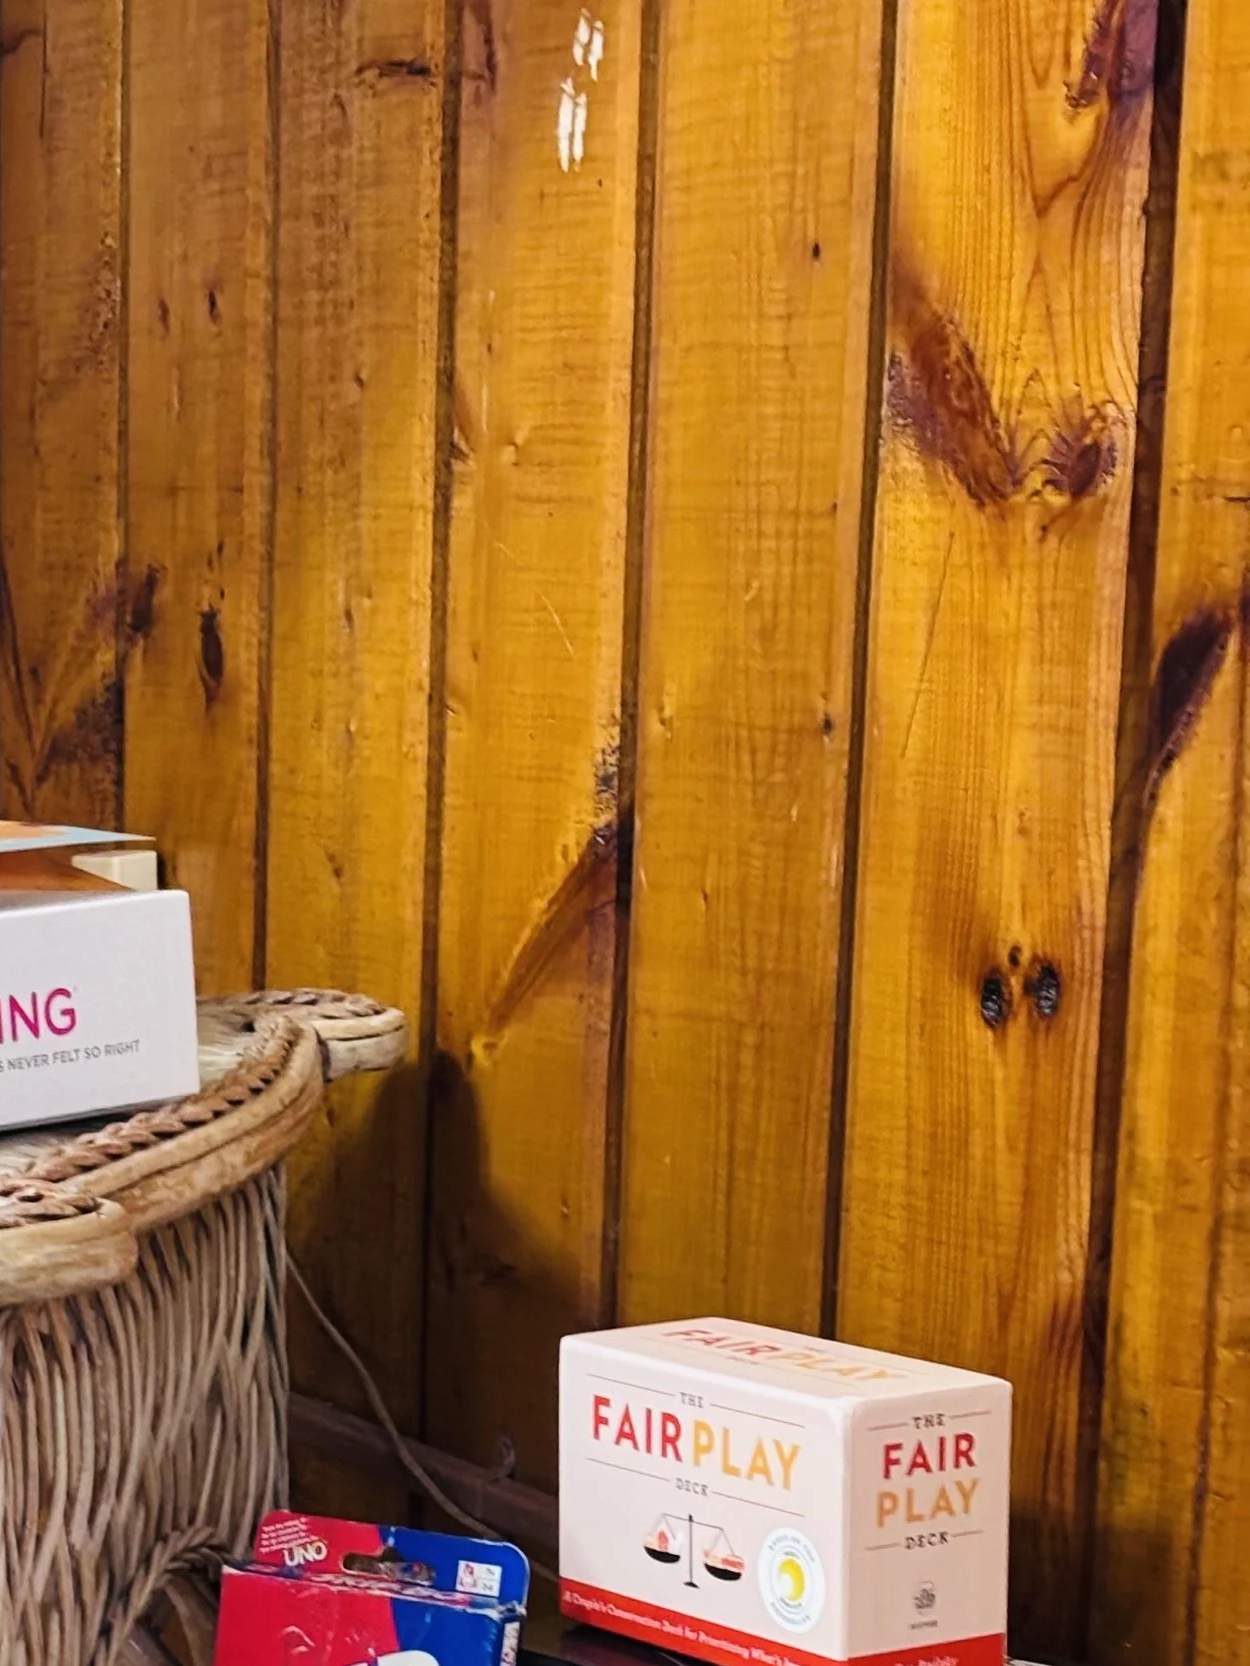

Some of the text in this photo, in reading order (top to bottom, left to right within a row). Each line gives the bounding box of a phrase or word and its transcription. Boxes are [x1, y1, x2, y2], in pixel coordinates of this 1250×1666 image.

[7, 1052, 50, 1071] NEVER
[52, 1048, 82, 1066] FELT
[84, 1045, 102, 1062] SO
[104, 1039, 140, 1057] RIGHT
[911, 1412, 946, 1430] THE
[591, 1393, 802, 1491] FAIR PLAY
[883, 1432, 978, 1480] FAIR
[874, 1477, 980, 1529] PLAY
[283, 1541, 328, 1567] UNO
[904, 1530, 949, 1551] DECK
